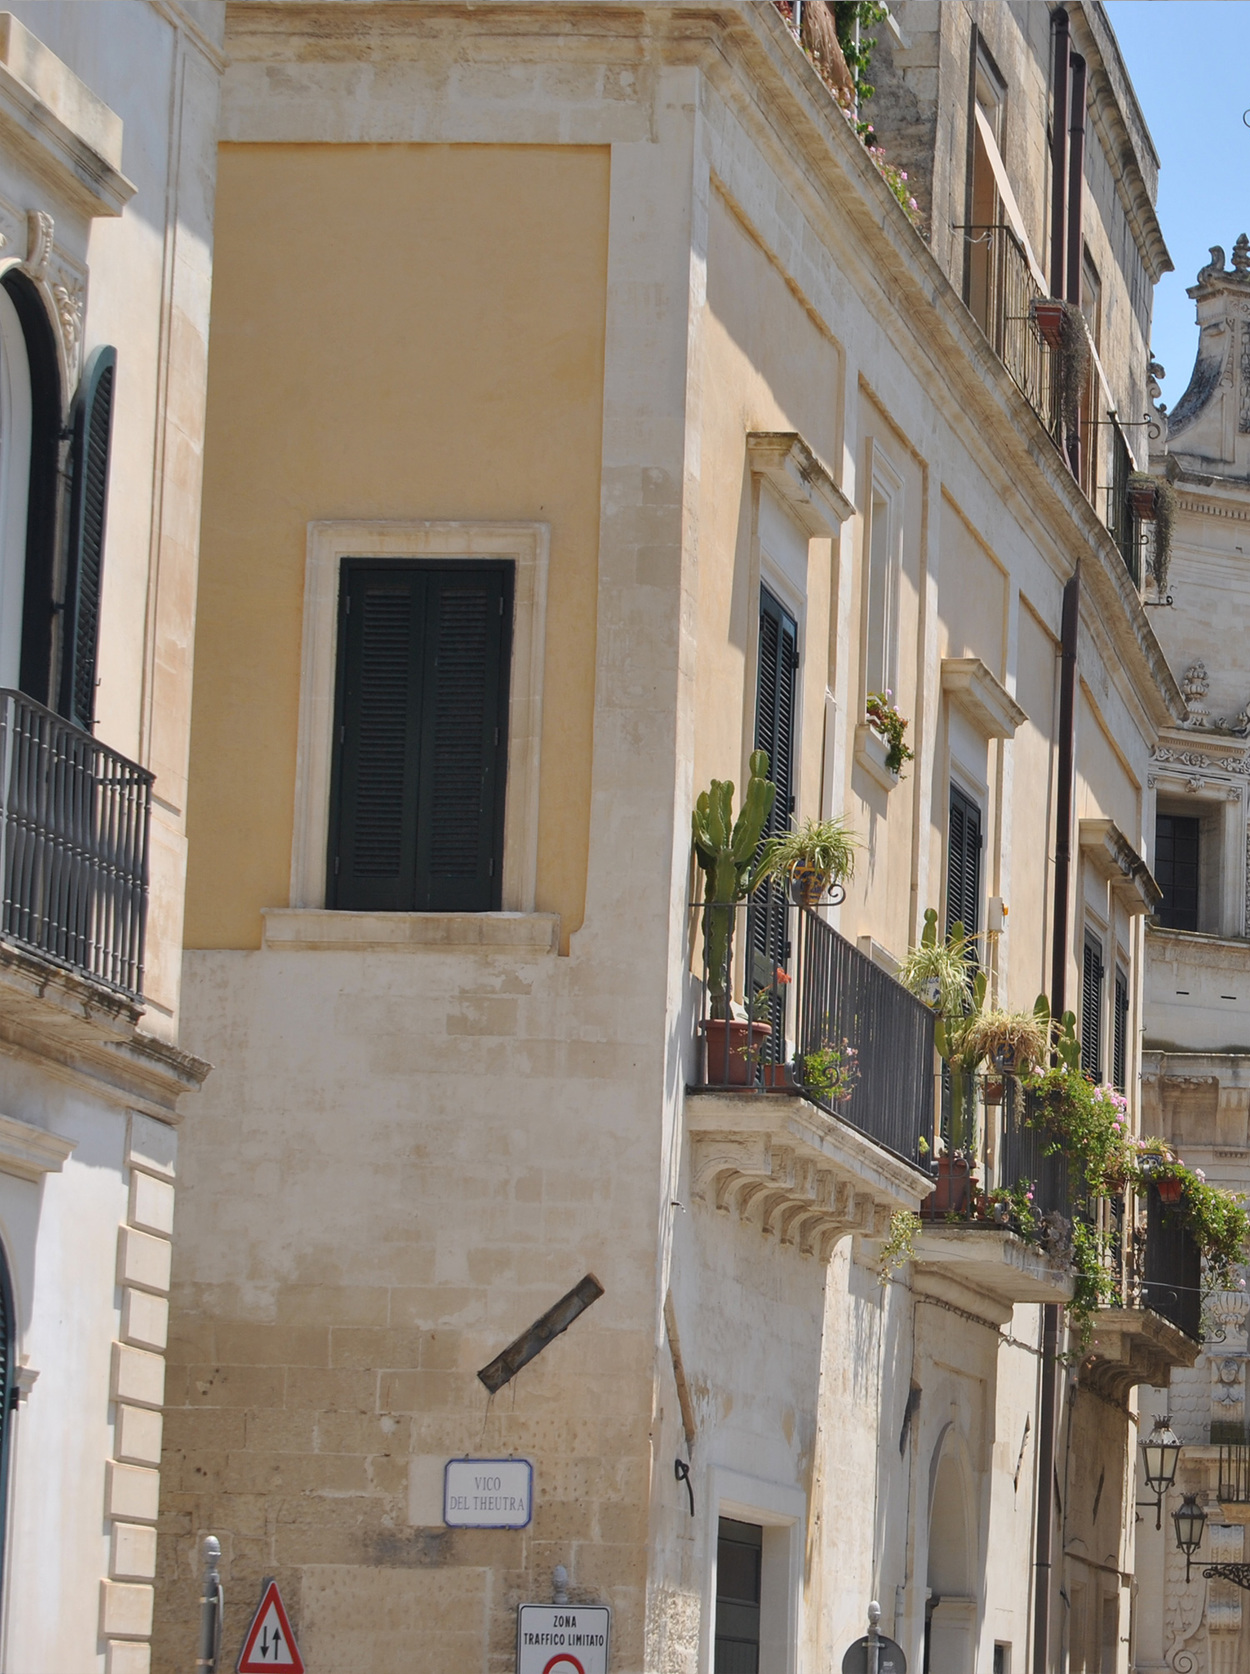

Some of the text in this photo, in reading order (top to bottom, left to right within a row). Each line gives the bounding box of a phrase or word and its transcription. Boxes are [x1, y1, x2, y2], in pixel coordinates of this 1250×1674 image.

[474, 1476, 502, 1491] VICO
[449, 1496, 525, 1511] DEL THEUTRA
[553, 1615, 577, 1628] ZONA
[523, 1632, 604, 1647] TRAFFICO LIMITATO
